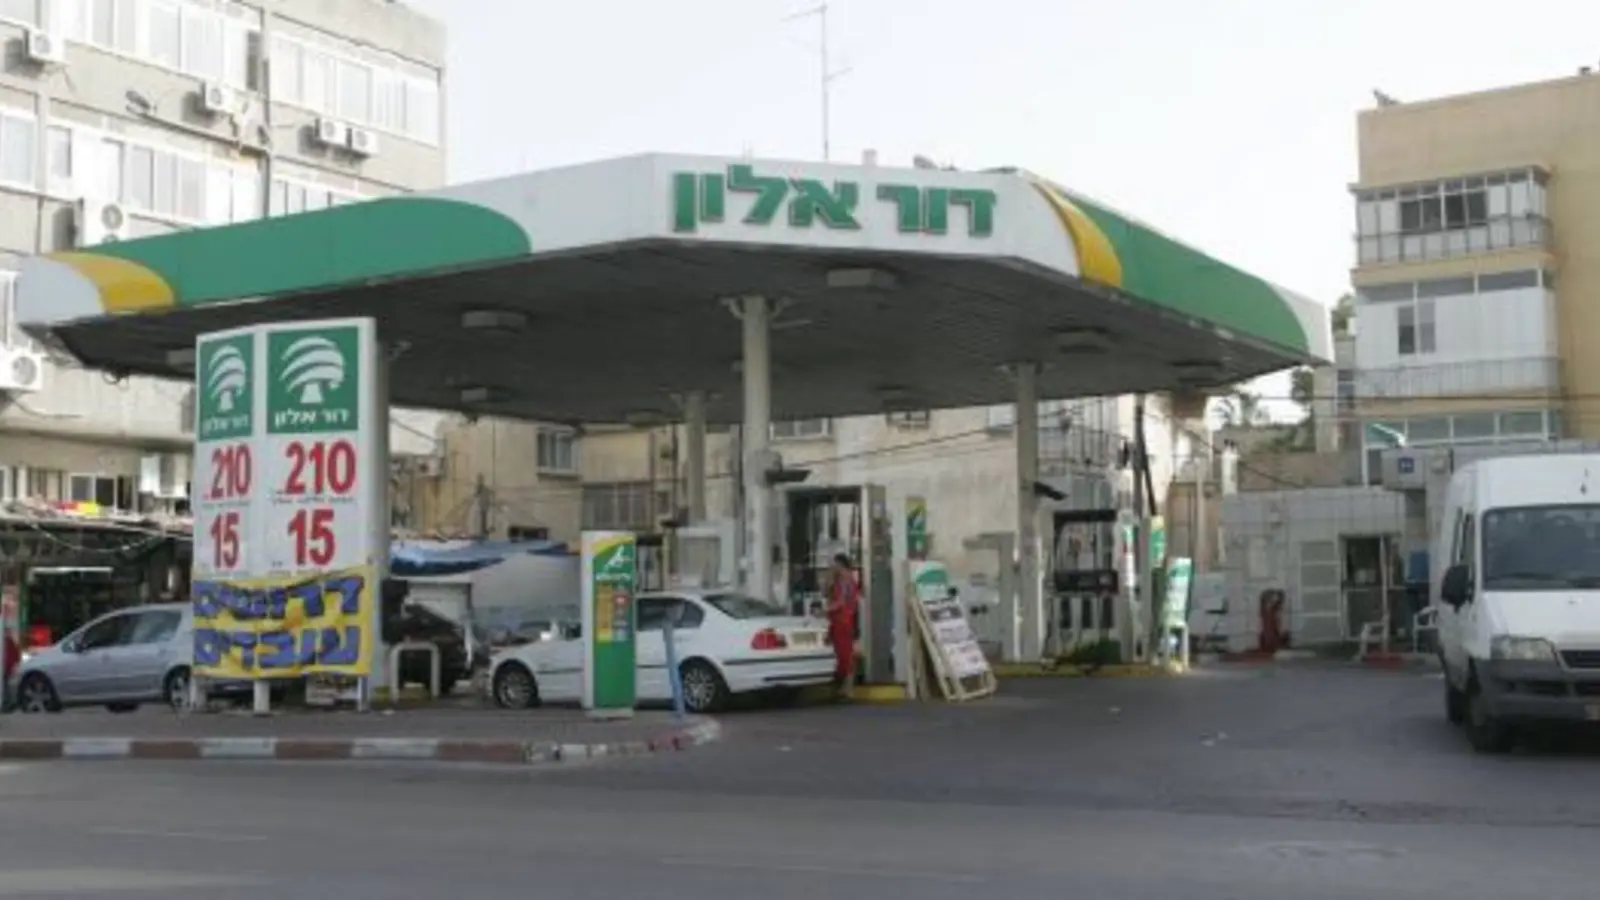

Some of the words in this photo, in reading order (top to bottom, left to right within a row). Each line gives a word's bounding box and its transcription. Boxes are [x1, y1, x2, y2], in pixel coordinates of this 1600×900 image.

[672, 163, 862, 232] אלון
[876, 184, 997, 238] דור
[274, 407, 316, 428] אלון
[320, 408, 350, 424] דור
[211, 444, 252, 498] 210
[285, 440, 357, 495] 210
[210, 511, 240, 568] 15
[287, 508, 336, 566] 15
[193, 575, 364, 619] דרושים
[193, 625, 361, 669] עובדים
